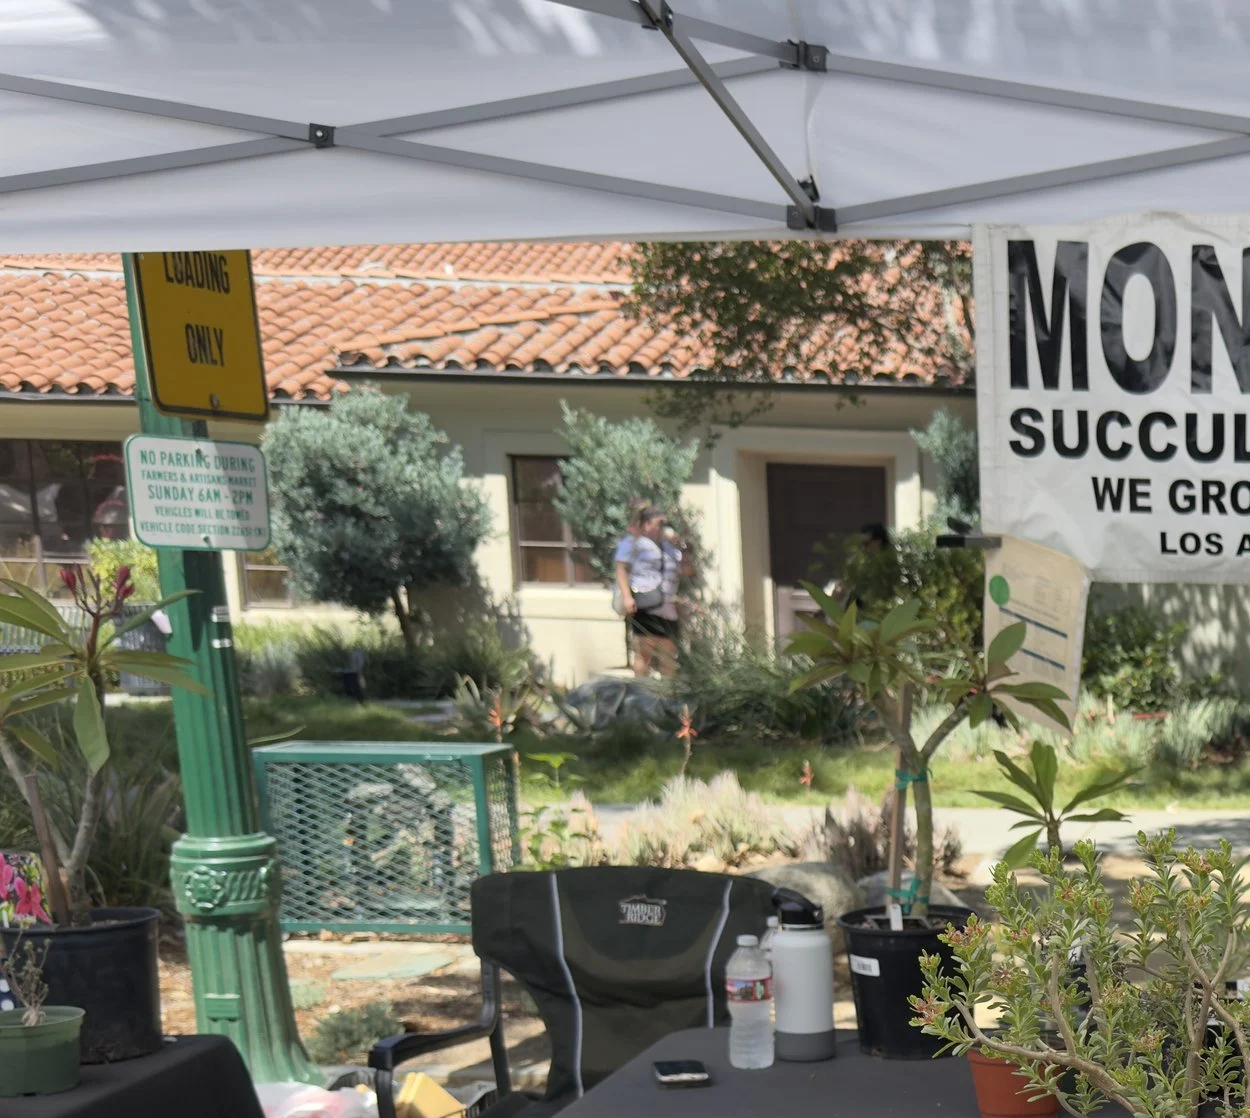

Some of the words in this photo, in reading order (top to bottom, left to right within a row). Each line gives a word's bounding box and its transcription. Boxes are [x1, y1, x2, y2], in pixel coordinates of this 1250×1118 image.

[163, 252, 230, 294] LOADING
[185, 323, 225, 367] ONLY
[140, 450, 156, 465] NO
[160, 452, 211, 469] PARKING
[214, 456, 255, 472] DURING
[142, 470, 177, 482] FARMERS
[147, 485, 194, 501] SUNDAY
[198, 488, 221, 502] 6AM
[231, 490, 253, 505] 2PM
[1092, 476, 1152, 514] WE
[155, 507, 193, 518] VEHICLES
[140, 521, 172, 533] VEHICLE
[1160, 532, 1224, 555] LOS
[619, 902, 661, 914] TIMBER
[627, 911, 662, 926] RIDGE
